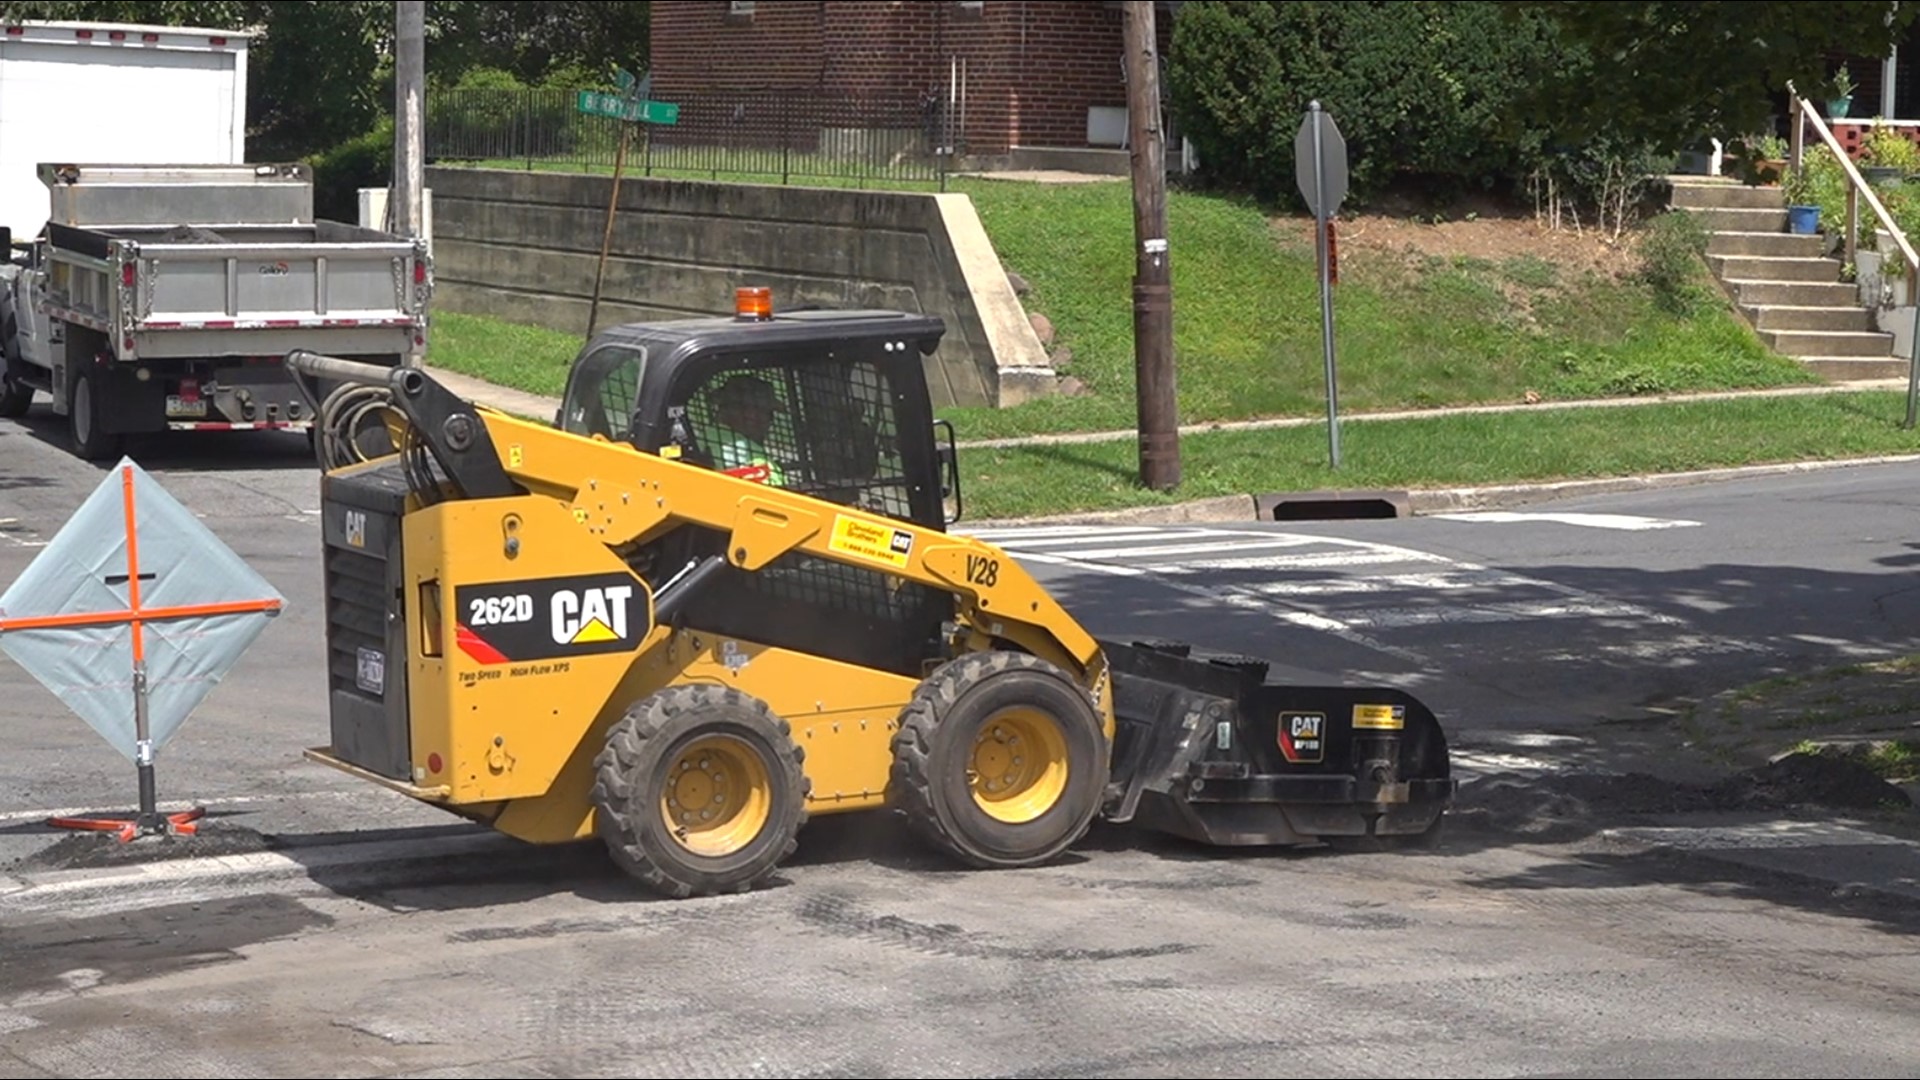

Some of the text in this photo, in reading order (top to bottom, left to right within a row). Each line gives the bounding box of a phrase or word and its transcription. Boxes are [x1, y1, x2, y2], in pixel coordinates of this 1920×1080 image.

[346, 510, 366, 548] CAT
[892, 534, 911, 550] CAT
[967, 554, 998, 588] V28
[470, 594, 533, 626] 262D
[551, 585, 632, 645] CAT
[1291, 716, 1321, 737] CAT
